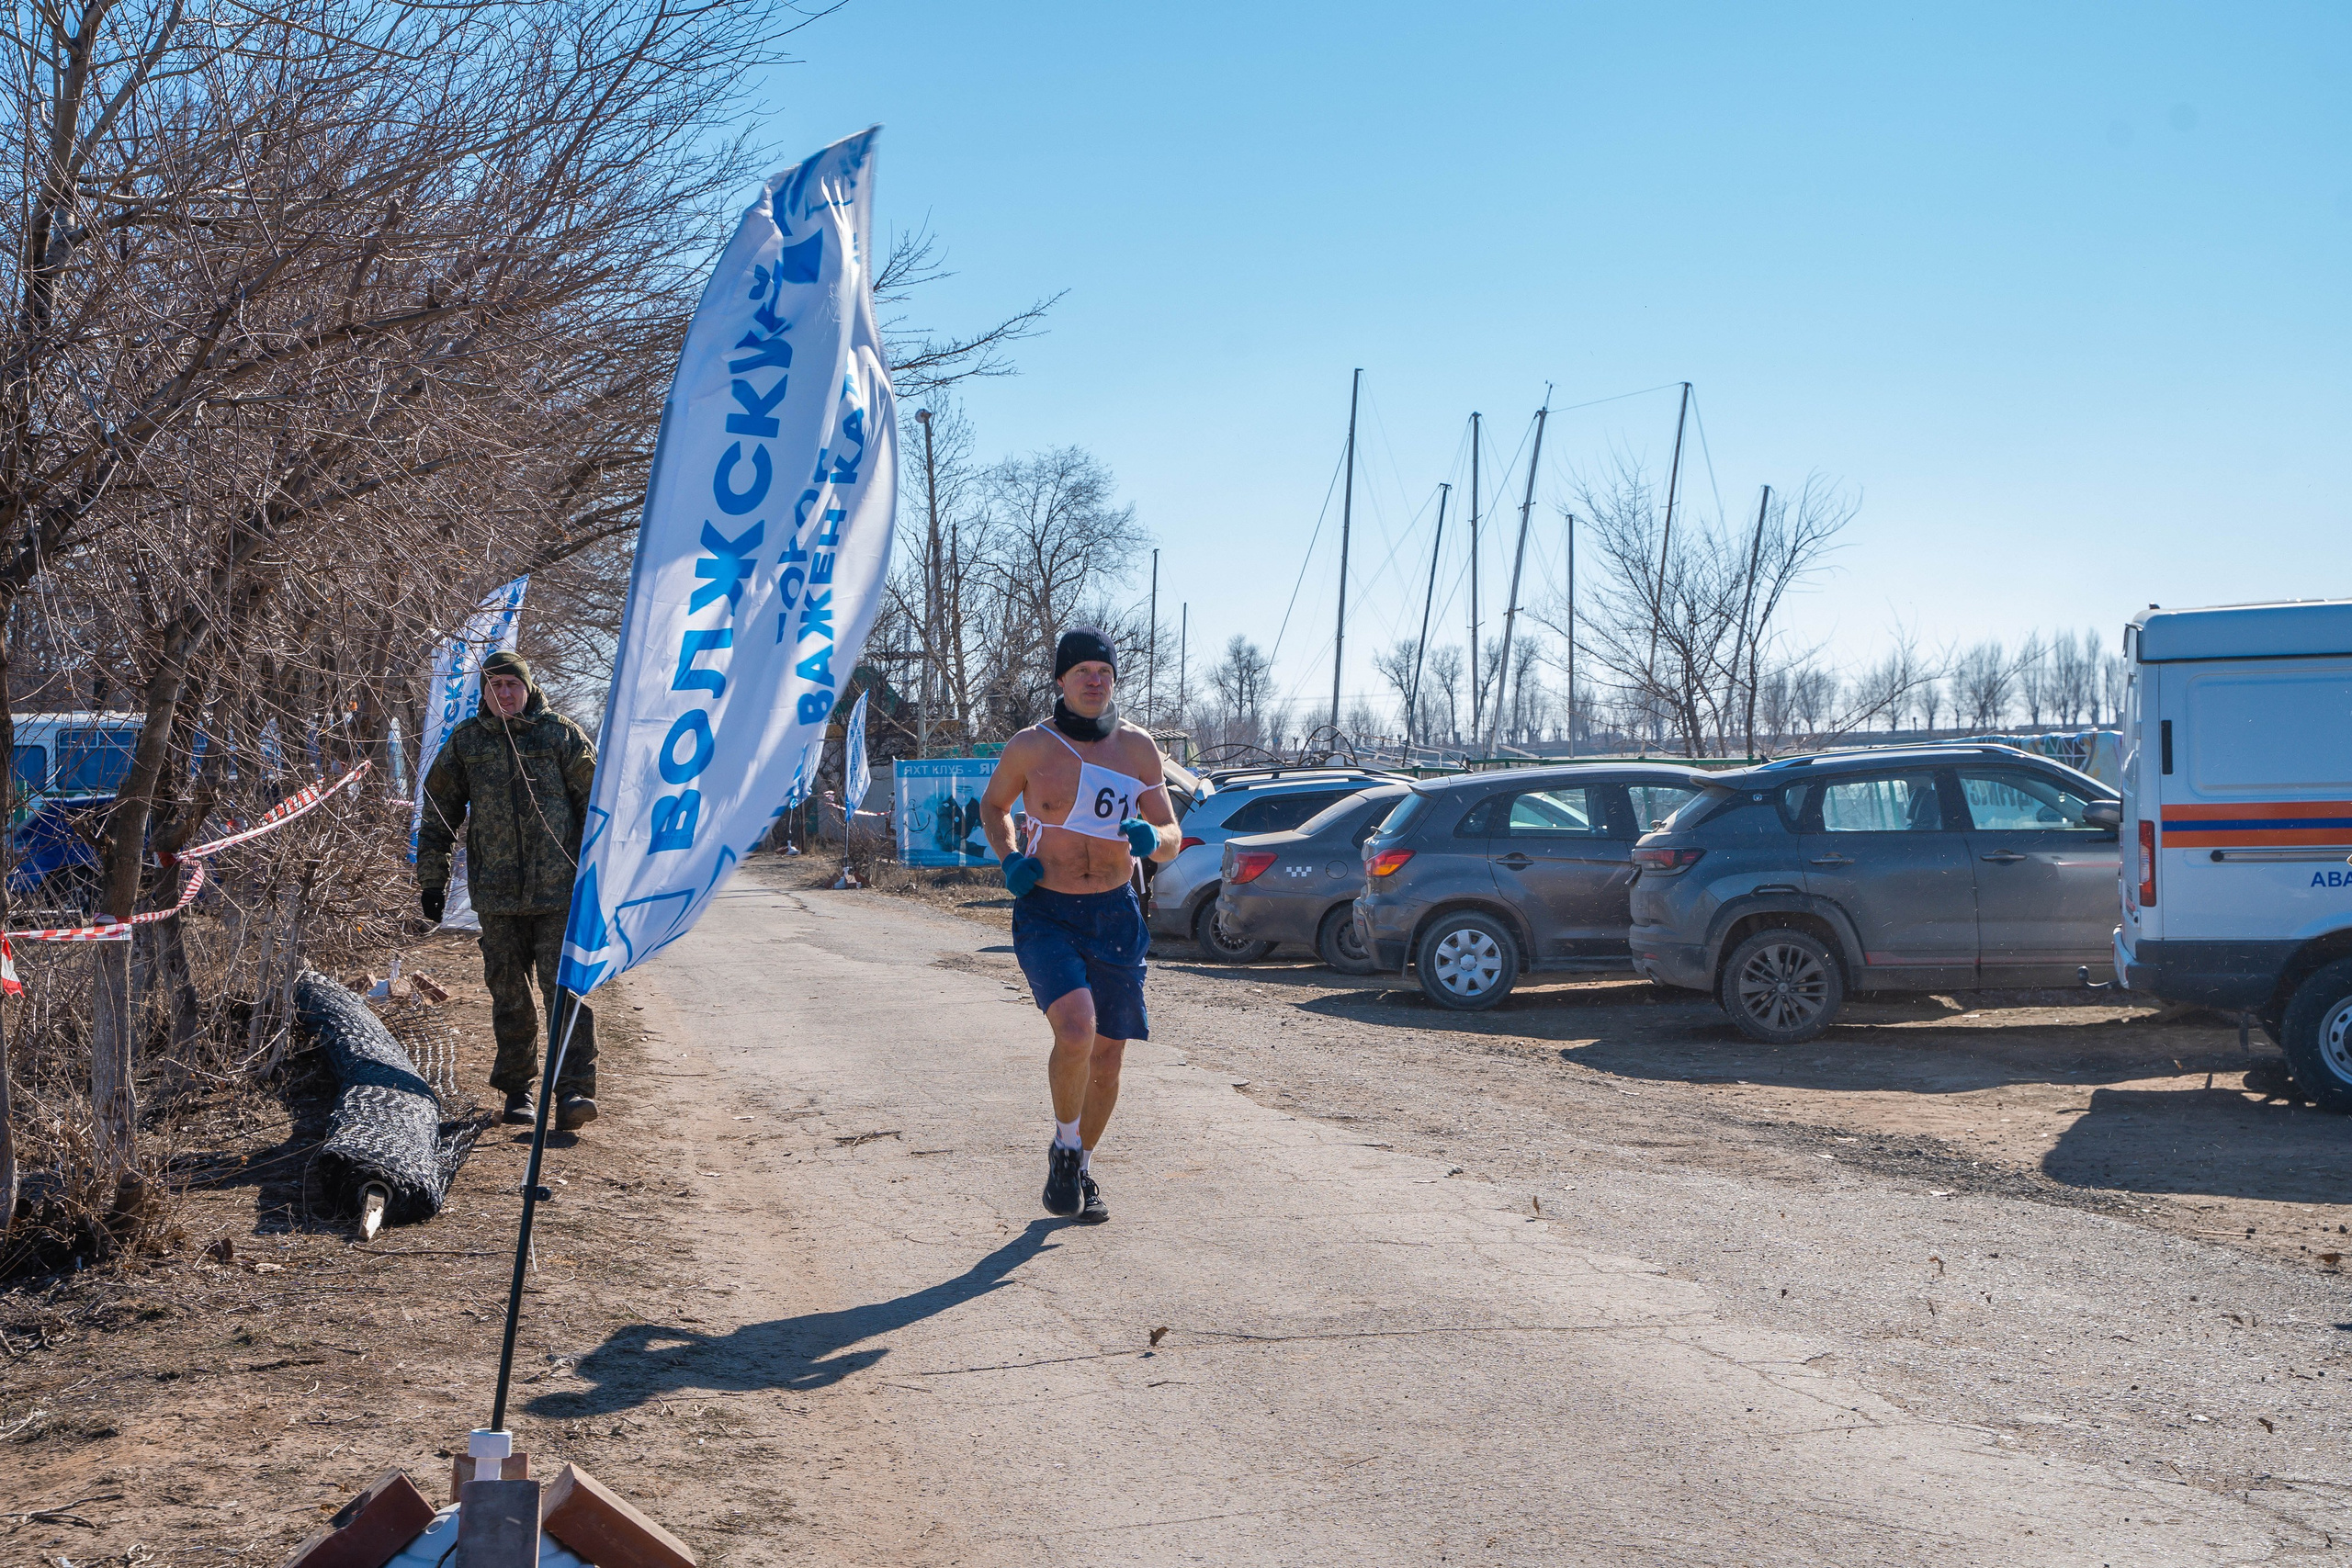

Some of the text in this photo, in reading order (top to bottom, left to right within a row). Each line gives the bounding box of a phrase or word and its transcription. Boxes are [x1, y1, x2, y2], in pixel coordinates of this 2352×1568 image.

[797, 509, 846, 726] ВАЖЕН
[904, 765, 929, 775] ЯХТ
[932, 764, 964, 774] КЛУБ
[1094, 787, 1129, 824] 61
